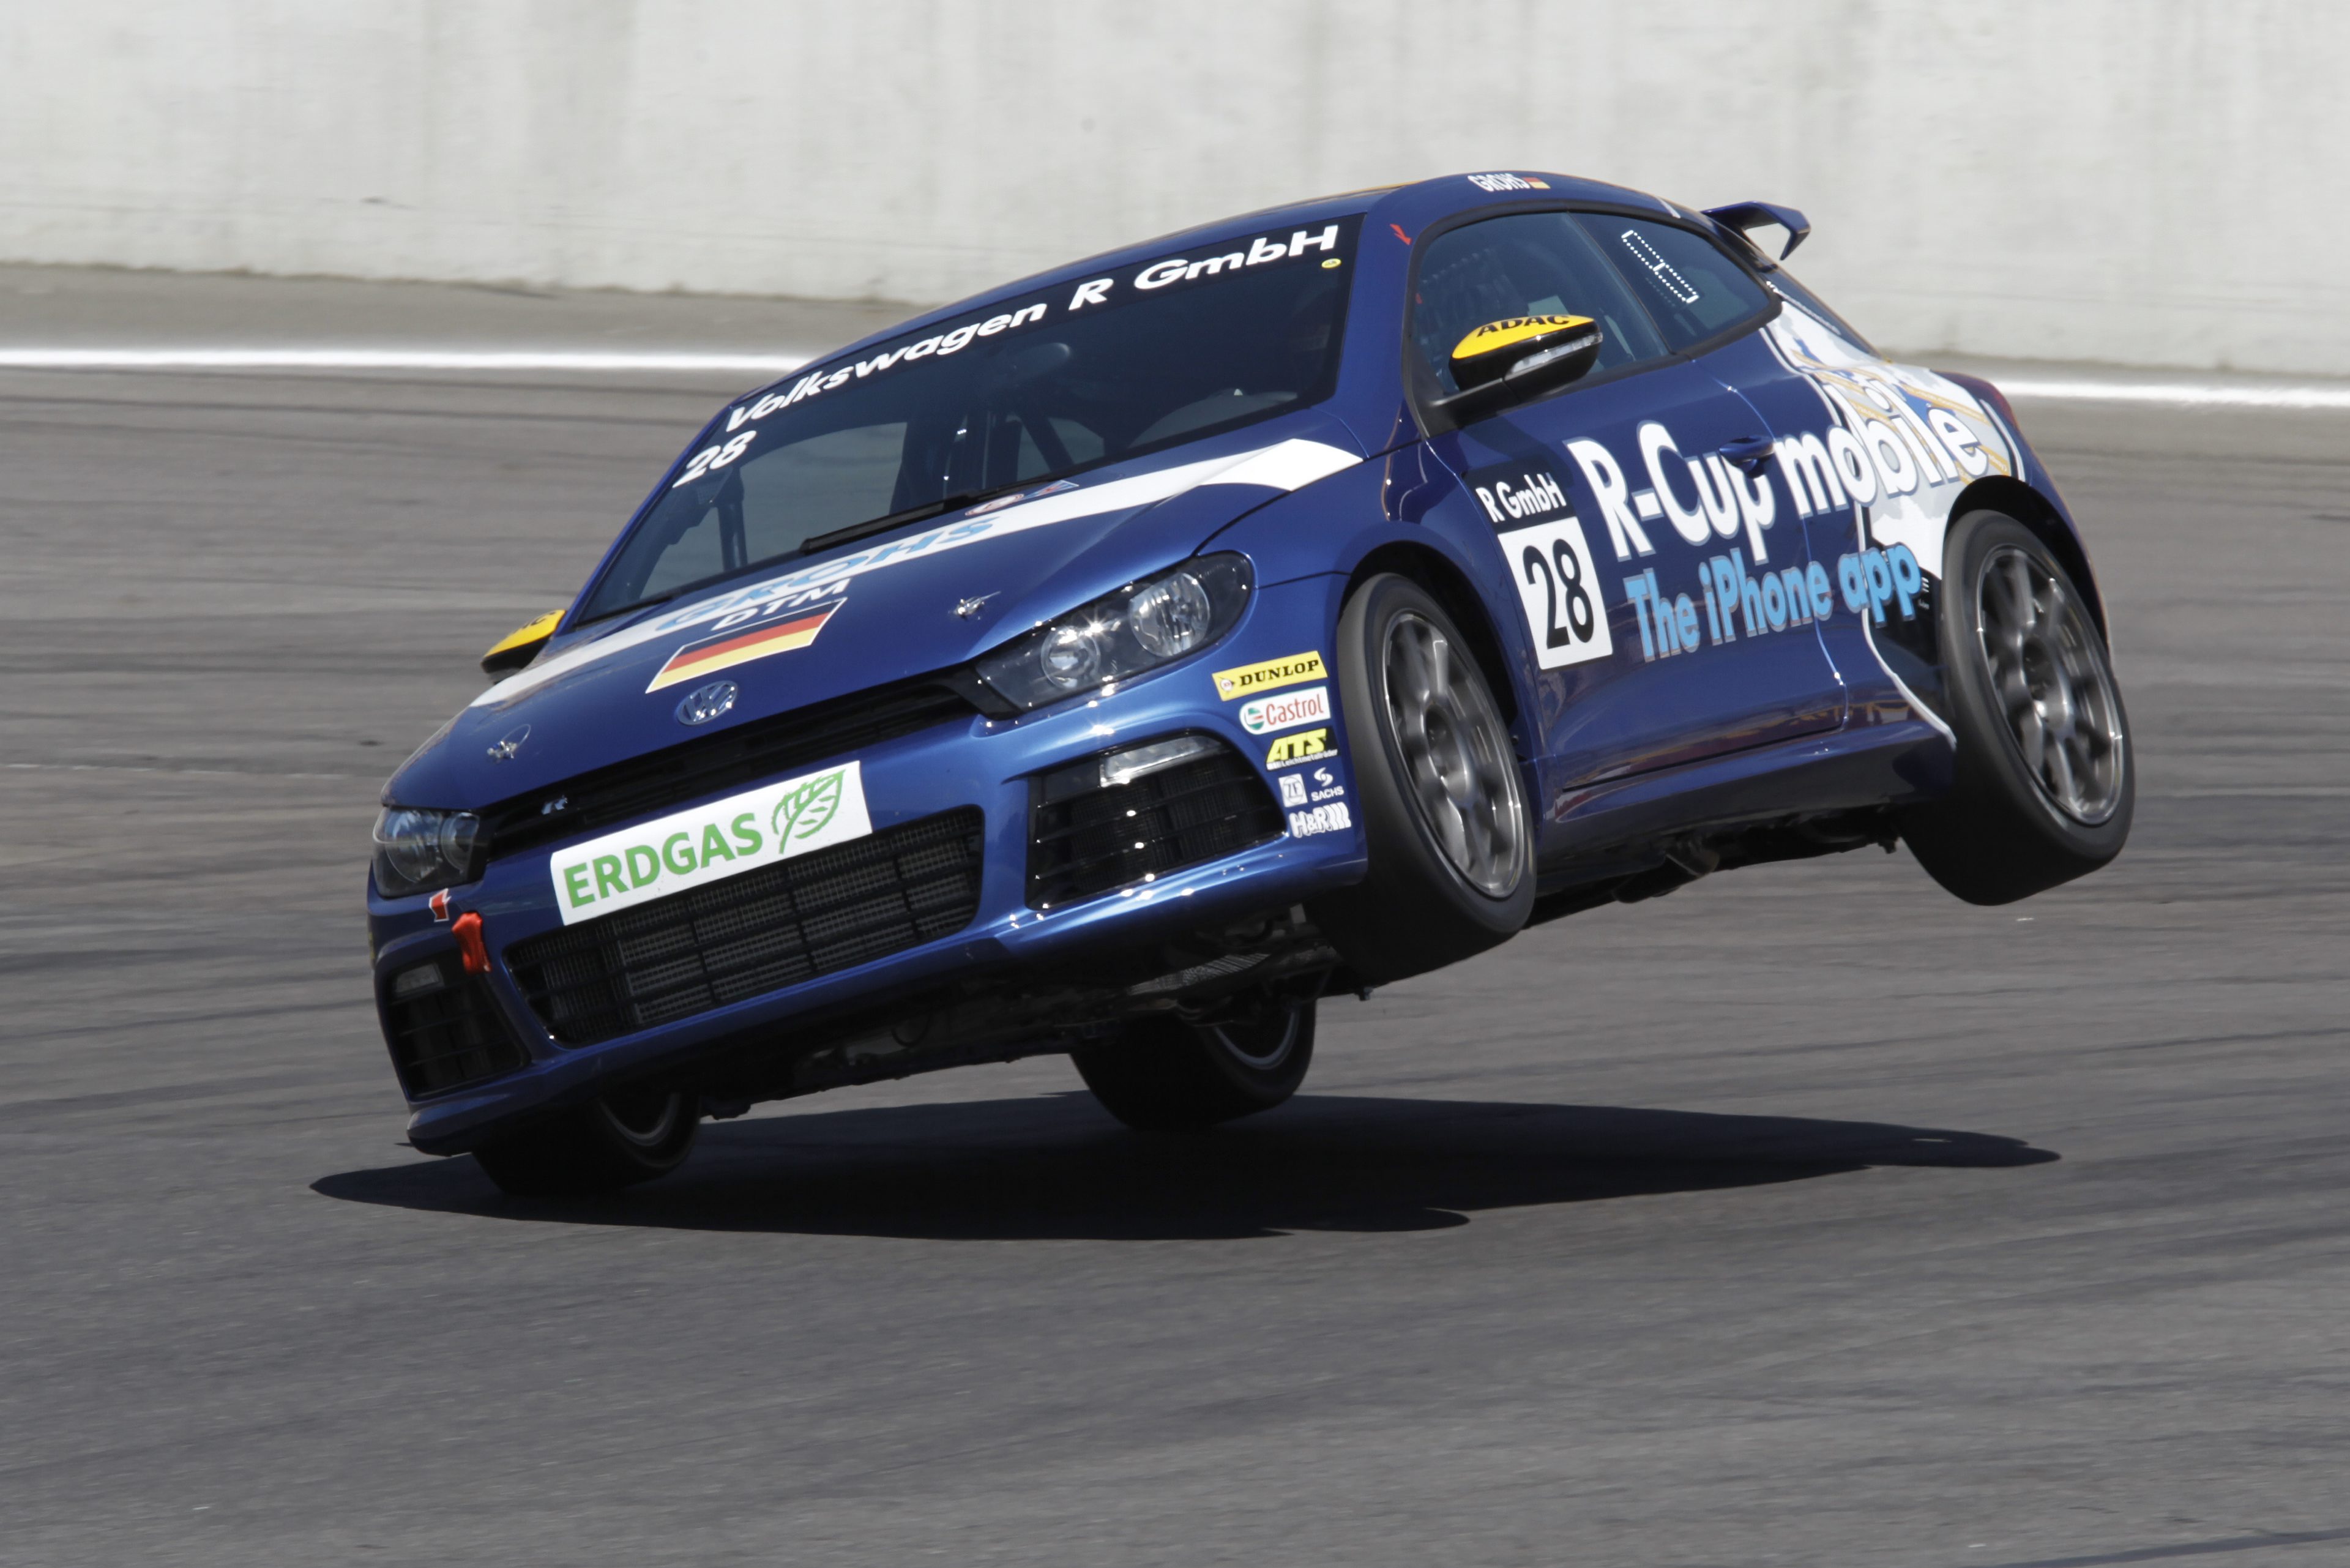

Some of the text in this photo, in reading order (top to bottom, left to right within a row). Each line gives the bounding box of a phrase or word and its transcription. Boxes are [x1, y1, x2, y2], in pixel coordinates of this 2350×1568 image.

[726, 224, 1339, 432] Volkswagen R GmbH
[1477, 315, 1571, 337] ADAC
[672, 430, 757, 488] 28
[1562, 378, 1989, 565] R-Cup mobile
[1475, 472, 1567, 523] R GmbH
[654, 516, 1000, 632] GROHS
[1522, 539, 1595, 650] 28
[711, 578, 852, 631] DTM
[1623, 542, 1923, 662] The iPhone app
[1239, 659, 1319, 687] DUNLOP
[1266, 693, 1324, 726] Castrol
[1266, 728, 1327, 764] ATS
[1311, 786, 1345, 802] SACHS
[1289, 805, 1334, 838] H&R
[564, 813, 763, 908] ERDGAS
